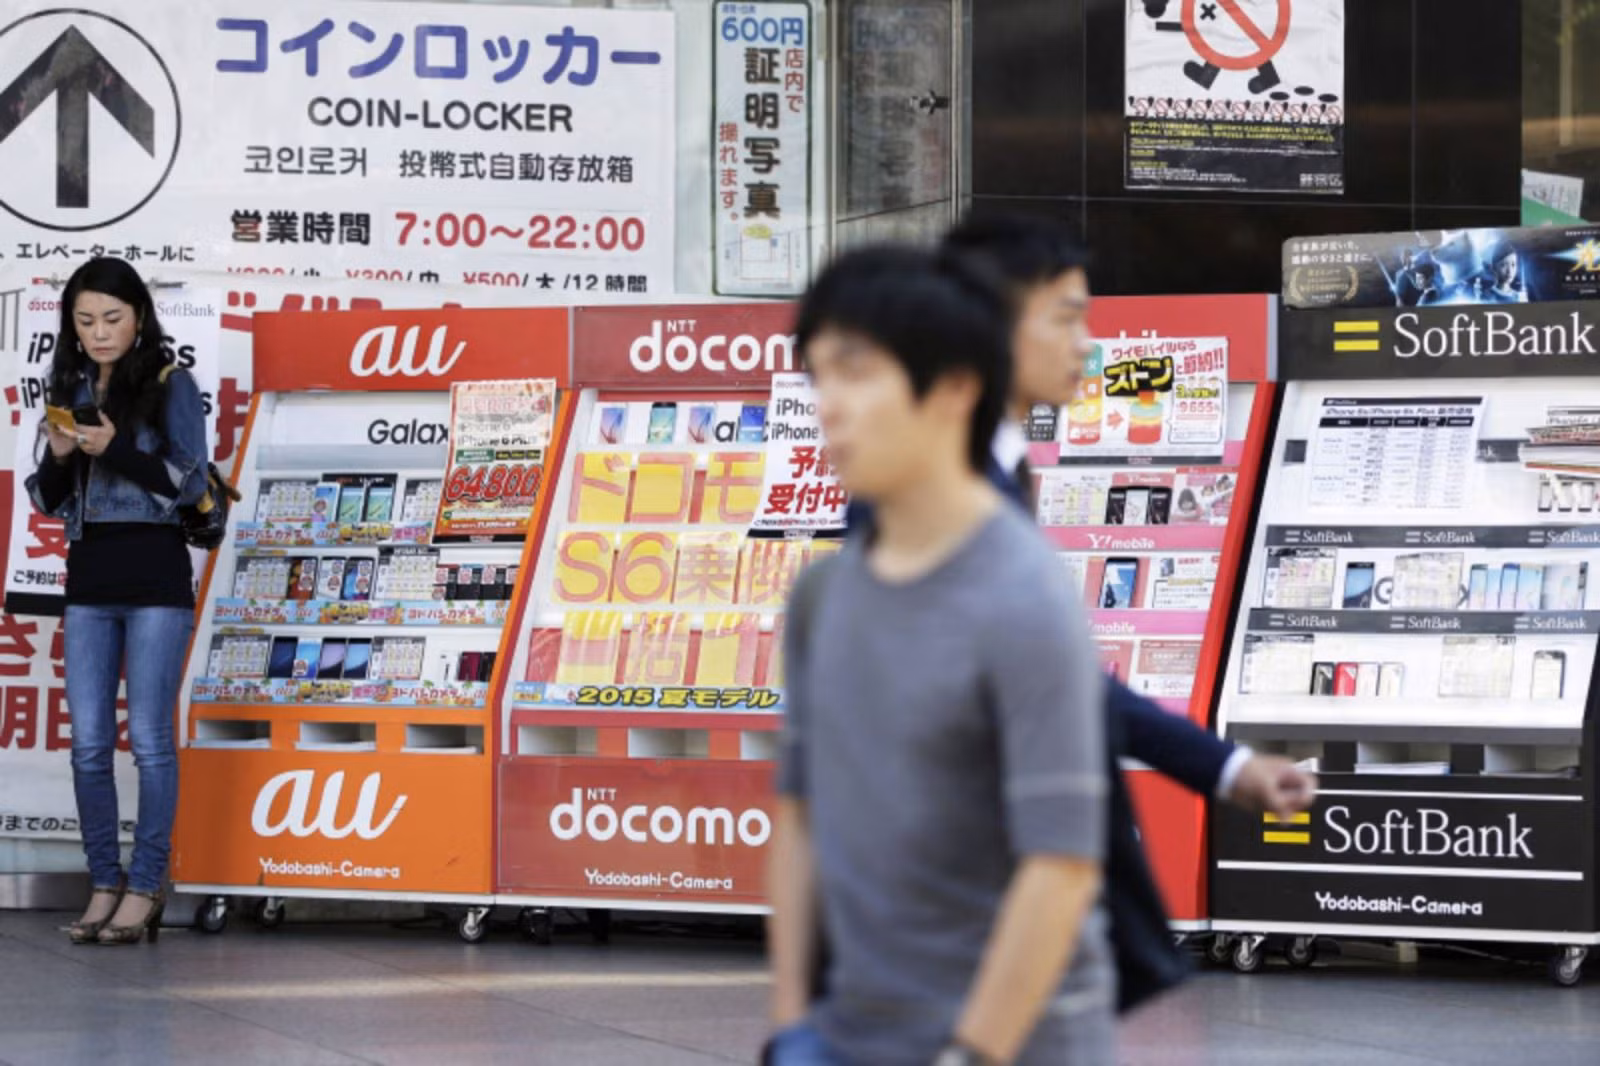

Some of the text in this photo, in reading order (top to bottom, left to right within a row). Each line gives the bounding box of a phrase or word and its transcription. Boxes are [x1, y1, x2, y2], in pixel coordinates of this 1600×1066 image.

[721, 16, 804, 45] 600円
[216, 18, 661, 86] コインロッカー
[785, 48, 804, 113] 店内で
[308, 96, 573, 132] COIN-LOCKER
[744, 47, 781, 219] 証明写真
[244, 145, 367, 177] 코인로커
[399, 150, 634, 184] 投幣式自動存放箱
[719, 122, 739, 220] 撮れます。
[231, 209, 371, 245] 営業時間
[157, 302, 215, 317] SoftBank
[666, 320, 697, 333] NTT
[349, 325, 467, 378] au
[629, 320, 796, 372] docom
[1393, 311, 1597, 358] SoftBank
[367, 418, 449, 445] Galax
[567, 451, 762, 525] ドコモ
[763, 481, 850, 515] 受付中
[1087, 533, 1155, 550] Y!mobile
[1302, 530, 1354, 544] SoftBank
[1422, 530, 1476, 544] SoftBank
[1286, 614, 1587, 630] SoftBank SoftBank SoftBank
[575, 685, 782, 709] 2015 夏モデル
[251, 770, 408, 840] au
[587, 788, 617, 800] NTT
[549, 787, 772, 847] docomo
[1323, 805, 1535, 858] SoftBank
[259, 857, 400, 879] Yodobashi-Camera
[584, 868, 734, 889] Yodobashi-Camera
[1315, 891, 1483, 915] Yodobashi-Camera
